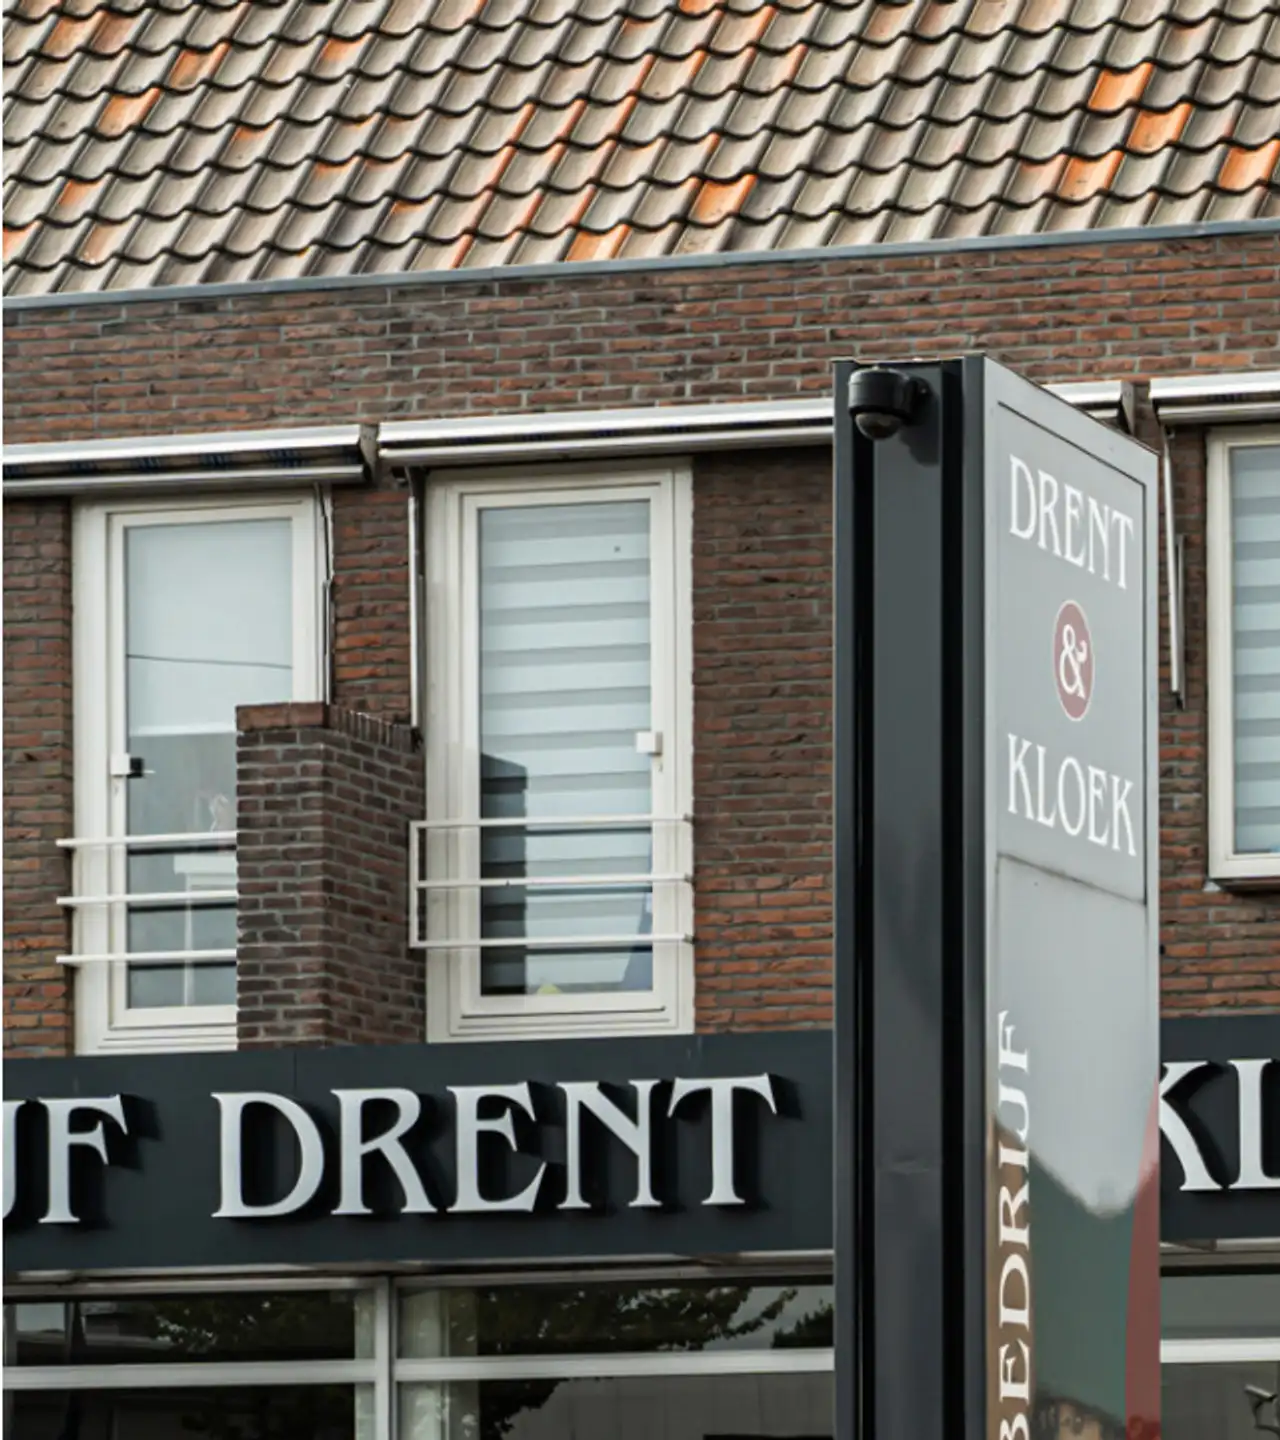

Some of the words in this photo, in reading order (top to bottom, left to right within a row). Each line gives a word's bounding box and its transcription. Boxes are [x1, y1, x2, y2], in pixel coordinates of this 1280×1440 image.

[1009, 454, 1135, 590] DRENT
[1058, 623, 1088, 700] &
[1007, 733, 1138, 857] KLOEK
[210, 1072, 777, 1220] DRENT
